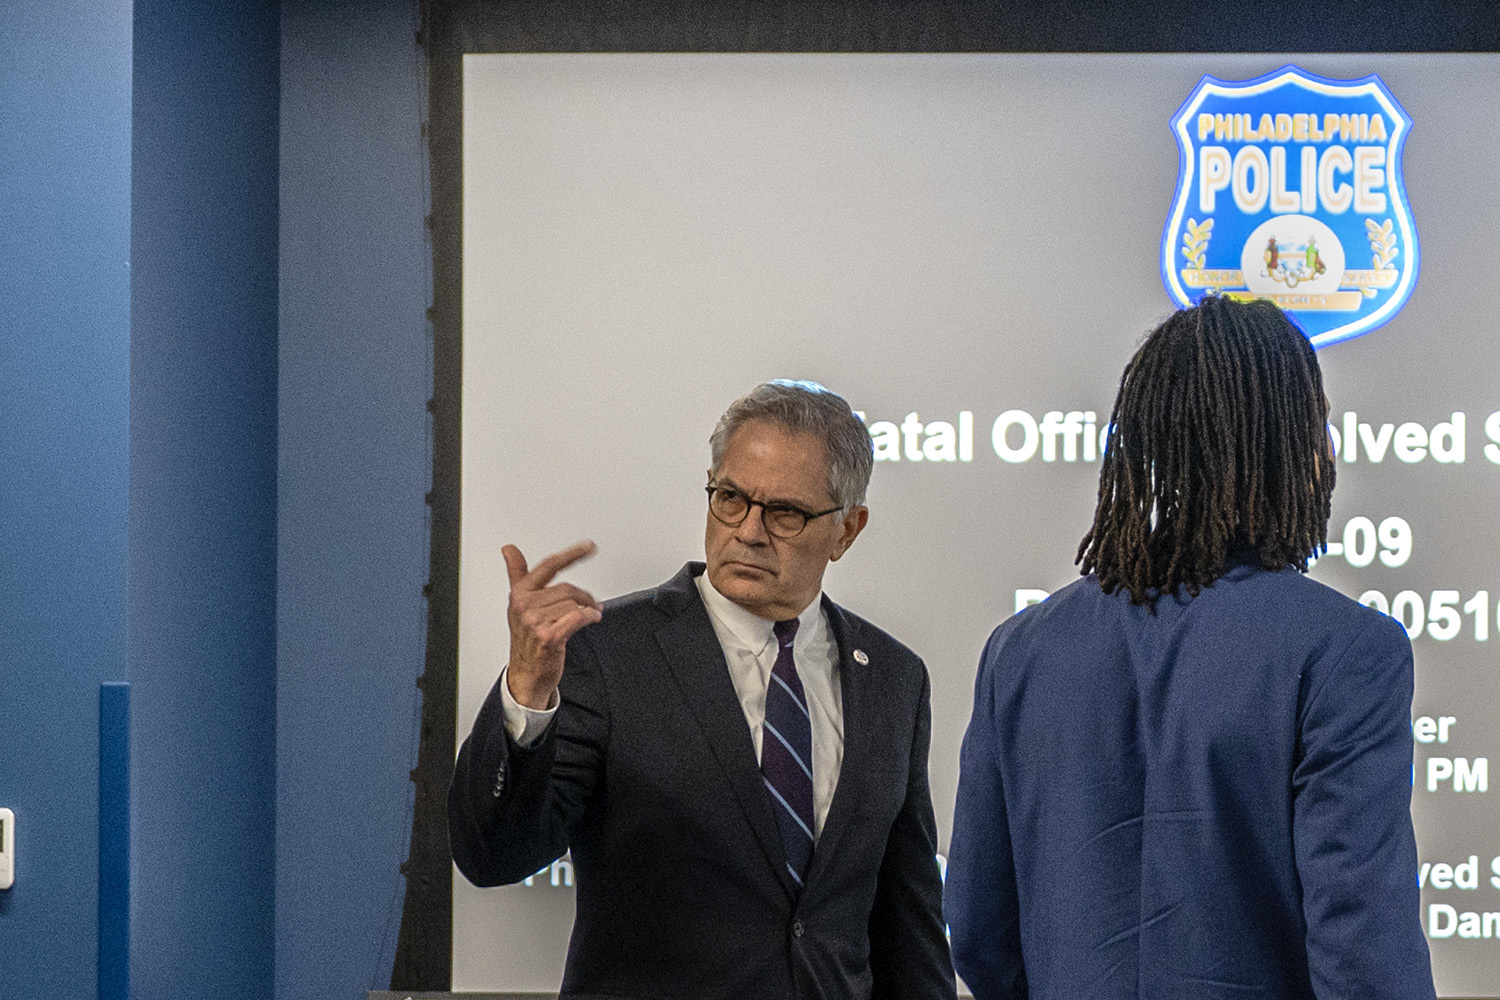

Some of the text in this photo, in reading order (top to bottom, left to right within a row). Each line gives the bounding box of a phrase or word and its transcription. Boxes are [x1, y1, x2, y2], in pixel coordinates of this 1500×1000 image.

[1198, 113, 1387, 141] PHILADELPHIA
[1199, 145, 1387, 214] POLICE
[853, 410, 973, 462] atal
[1307, 516, 1412, 568] -09
[1412, 716, 1457, 743] er
[1427, 757, 1488, 792] PM
